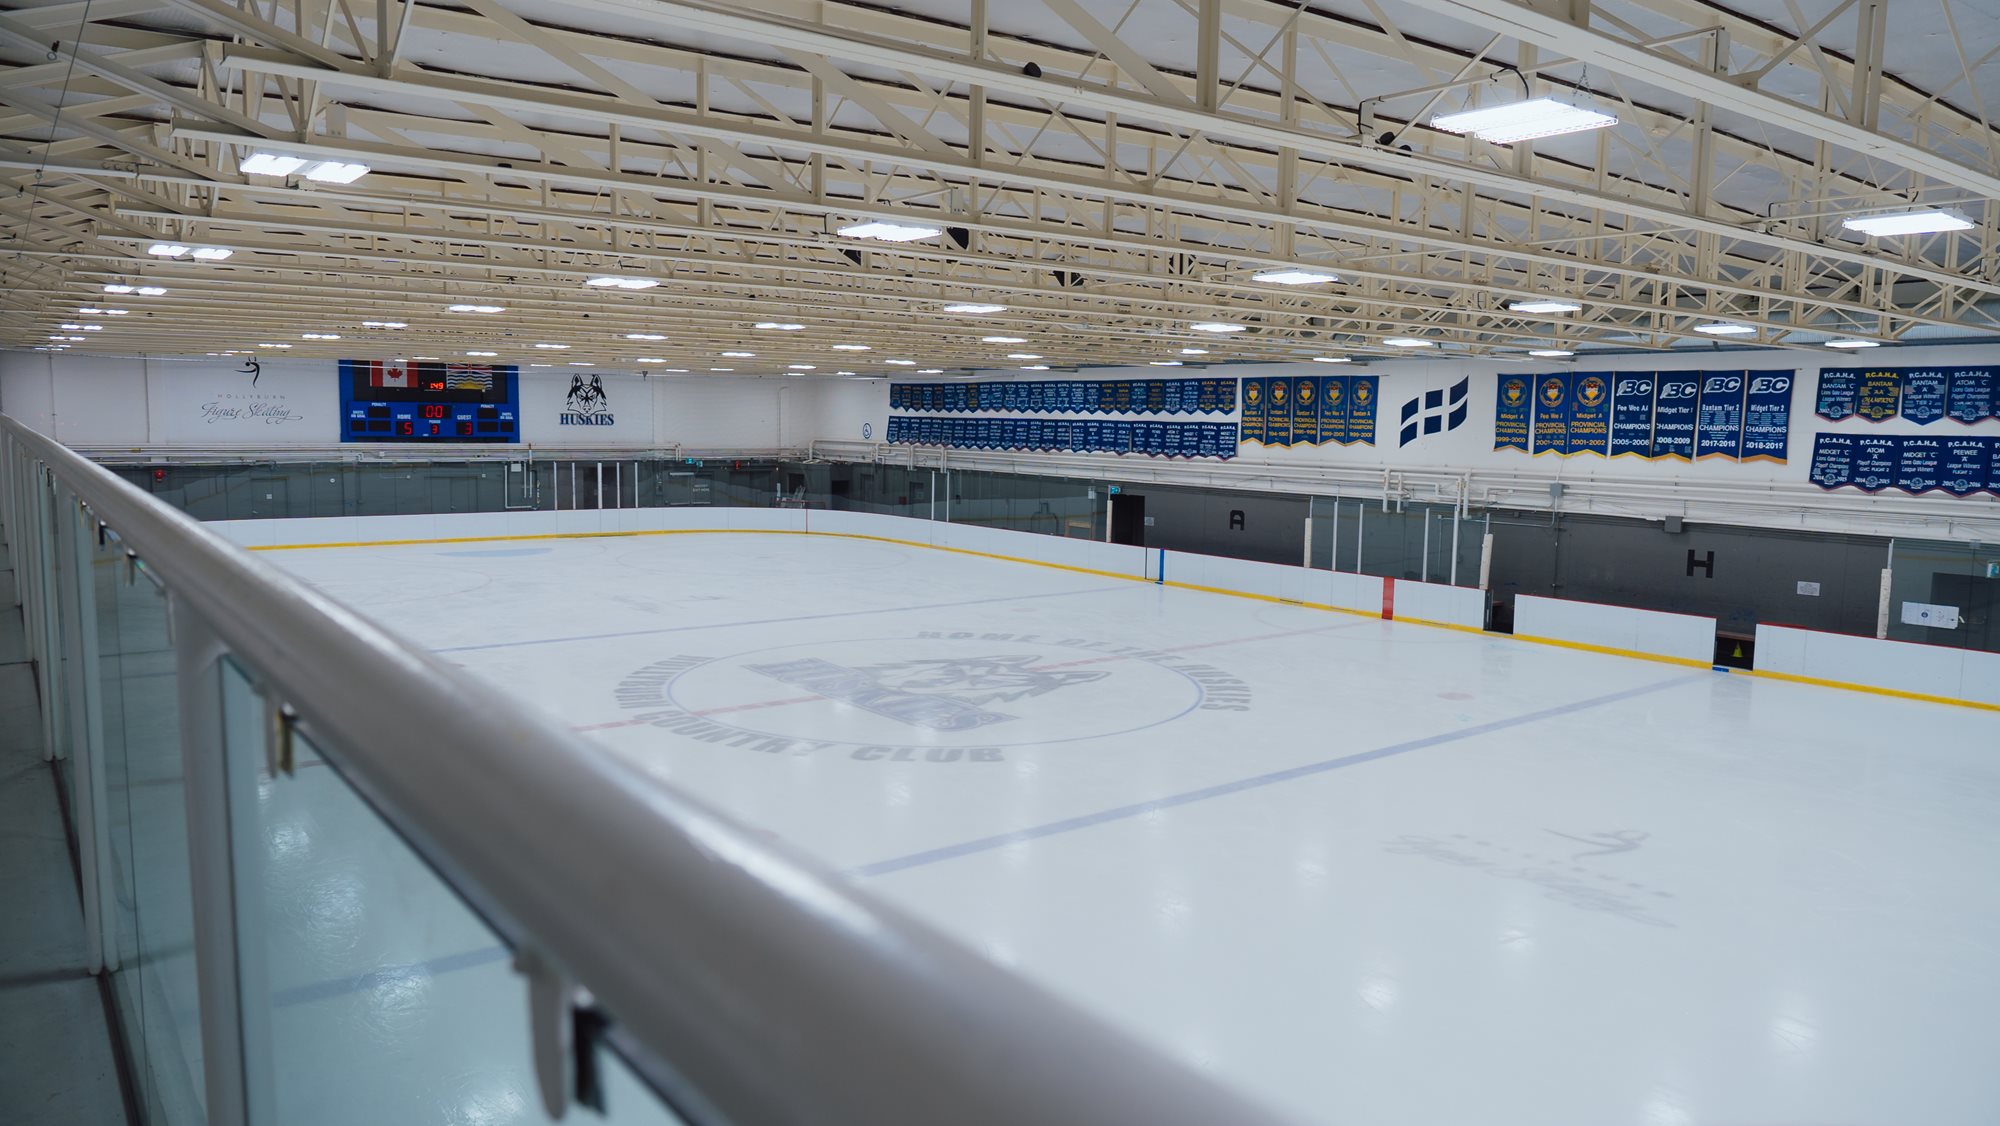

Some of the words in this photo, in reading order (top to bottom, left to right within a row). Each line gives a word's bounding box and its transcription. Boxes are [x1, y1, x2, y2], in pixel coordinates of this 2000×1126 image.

[1619, 380, 1652, 396] BC
[1661, 382, 1697, 398] BC
[1705, 377, 1741, 392] BC
[1751, 377, 1790, 393] BC
[201, 402, 242, 424] Figure
[242, 402, 304, 424] Skating
[560, 413, 614, 426] HUSKIES
[404, 422, 412, 435] 5
[432, 424, 438, 434] 3
[465, 422, 472, 435] 3
[1230, 510, 1244, 530] A
[1686, 549, 1714, 578] H
[849, 746, 1007, 763] CLUB
